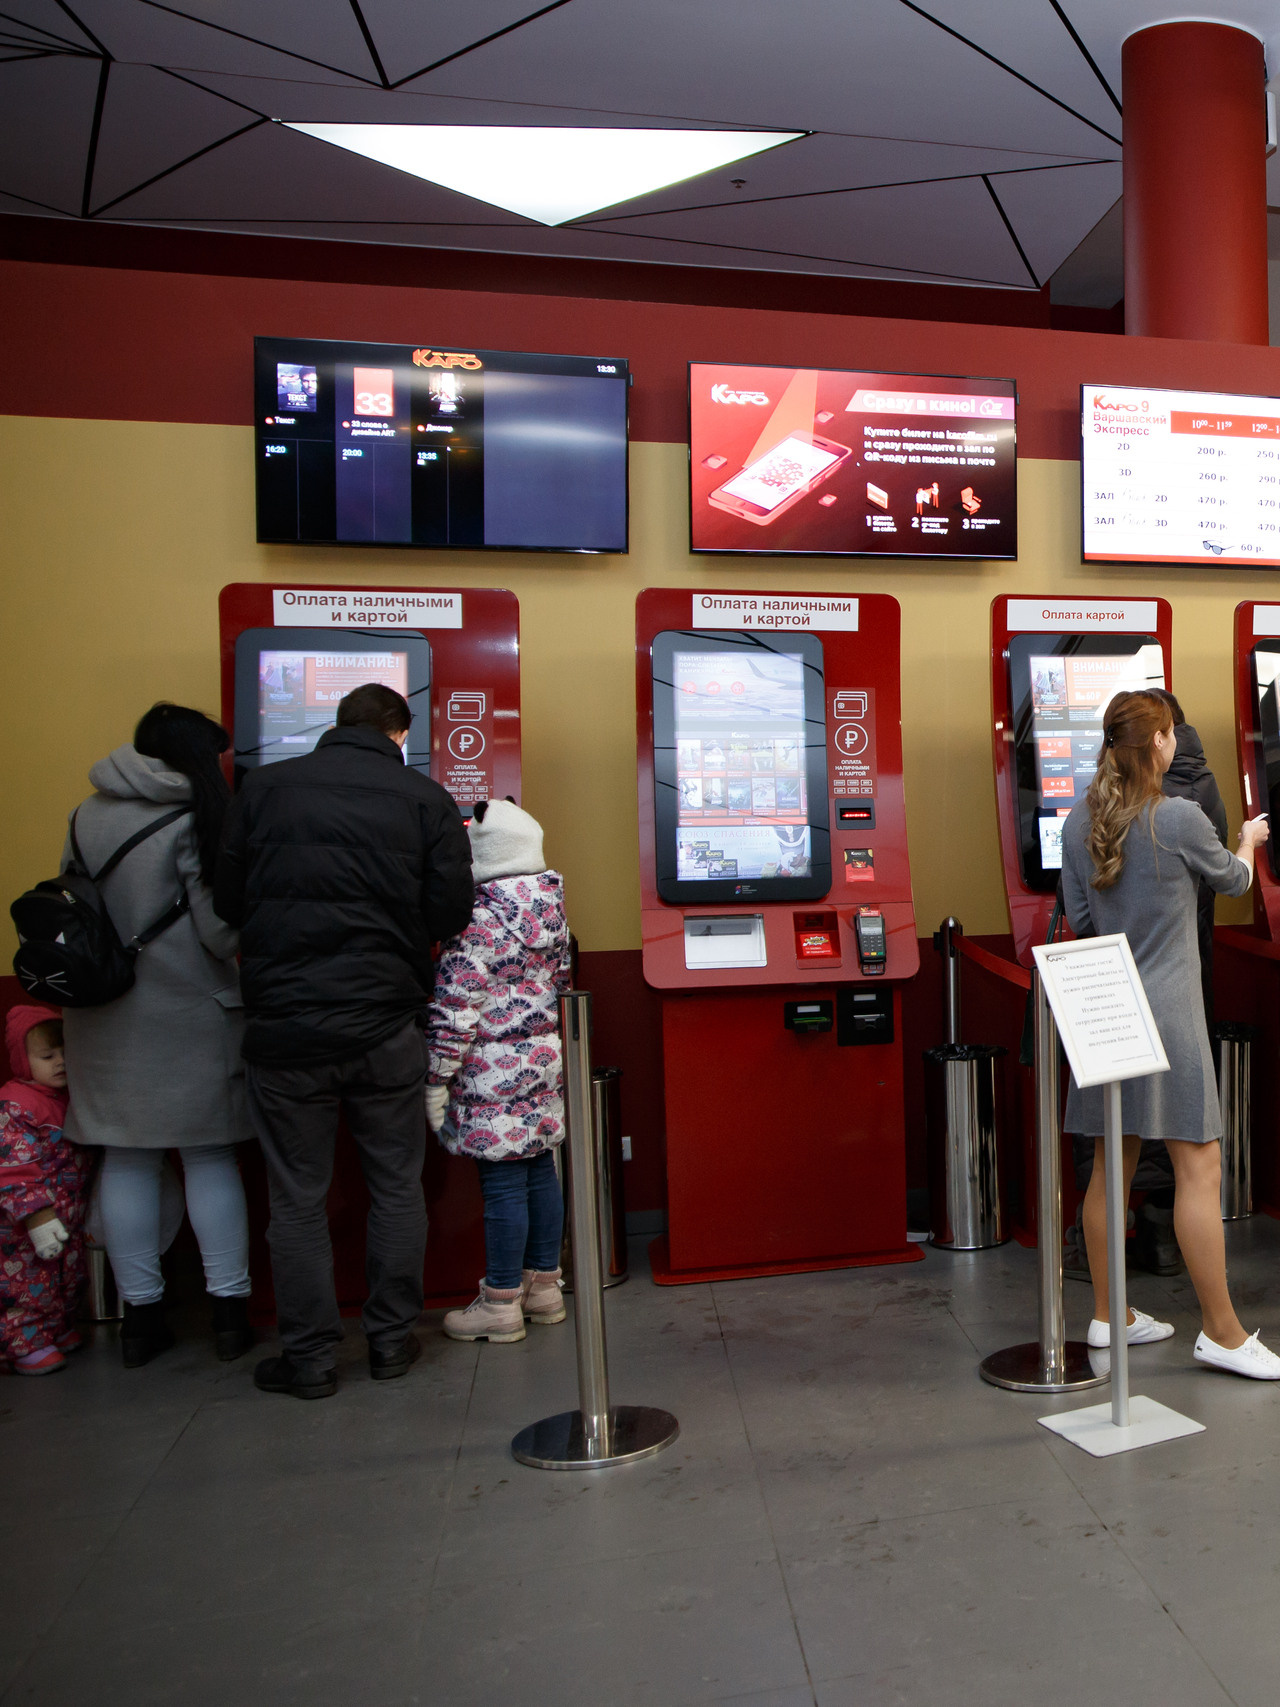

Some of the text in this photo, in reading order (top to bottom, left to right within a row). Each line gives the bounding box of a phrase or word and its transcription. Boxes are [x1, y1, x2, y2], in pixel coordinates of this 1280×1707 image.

[356, 392, 392, 414] 33
[862, 393, 976, 413] Сразу в кино!
[1141, 400, 1149, 412] 9
[1093, 411, 1167, 424] Варшавский
[381, 429, 396, 437] ART
[864, 426, 900, 438] Купите
[901, 428, 931, 438] билет
[932, 431, 945, 439] на
[1093, 424, 1150, 436] Экспресс
[265, 445, 287, 454] 16:20
[342, 449, 363, 457] 20:00
[872, 441, 901, 451] сразу
[902, 442, 955, 453] проходите
[964, 445, 981, 453] зал
[982, 445, 995, 454] по
[1197, 447, 1215, 455] 200
[864, 452, 907, 464] QR-коду
[908, 455, 921, 463] из
[922, 455, 959, 465] письма
[967, 457, 996, 467] почте
[1118, 468, 1132, 477] 3D
[1094, 492, 1115, 500] ЗАЛ
[1155, 494, 1168, 503] 2D
[1197, 496, 1217, 505] 470
[1257, 499, 1275, 508] 470
[911, 516, 920, 528] 2
[962, 518, 970, 530] 3
[1094, 516, 1115, 525] ЗАЛ
[1155, 519, 1168, 528] 3D
[1197, 521, 1217, 530] 470
[1257, 523, 1275, 532] 470
[1240, 543, 1253, 552] 60
[283, 593, 453, 608] Оплата наличными
[701, 597, 851, 612] Оплата наличными
[331, 610, 408, 625] и картой
[743, 613, 810, 628] и картой
[1042, 610, 1125, 623] Оплата картой
[316, 656, 400, 668] ВНИМАНИЕ!
[1073, 662, 1128, 673] ВНИМАН
[330, 691, 341, 700] 60
[714, 830, 770, 838] СПАСЕНИЯ
